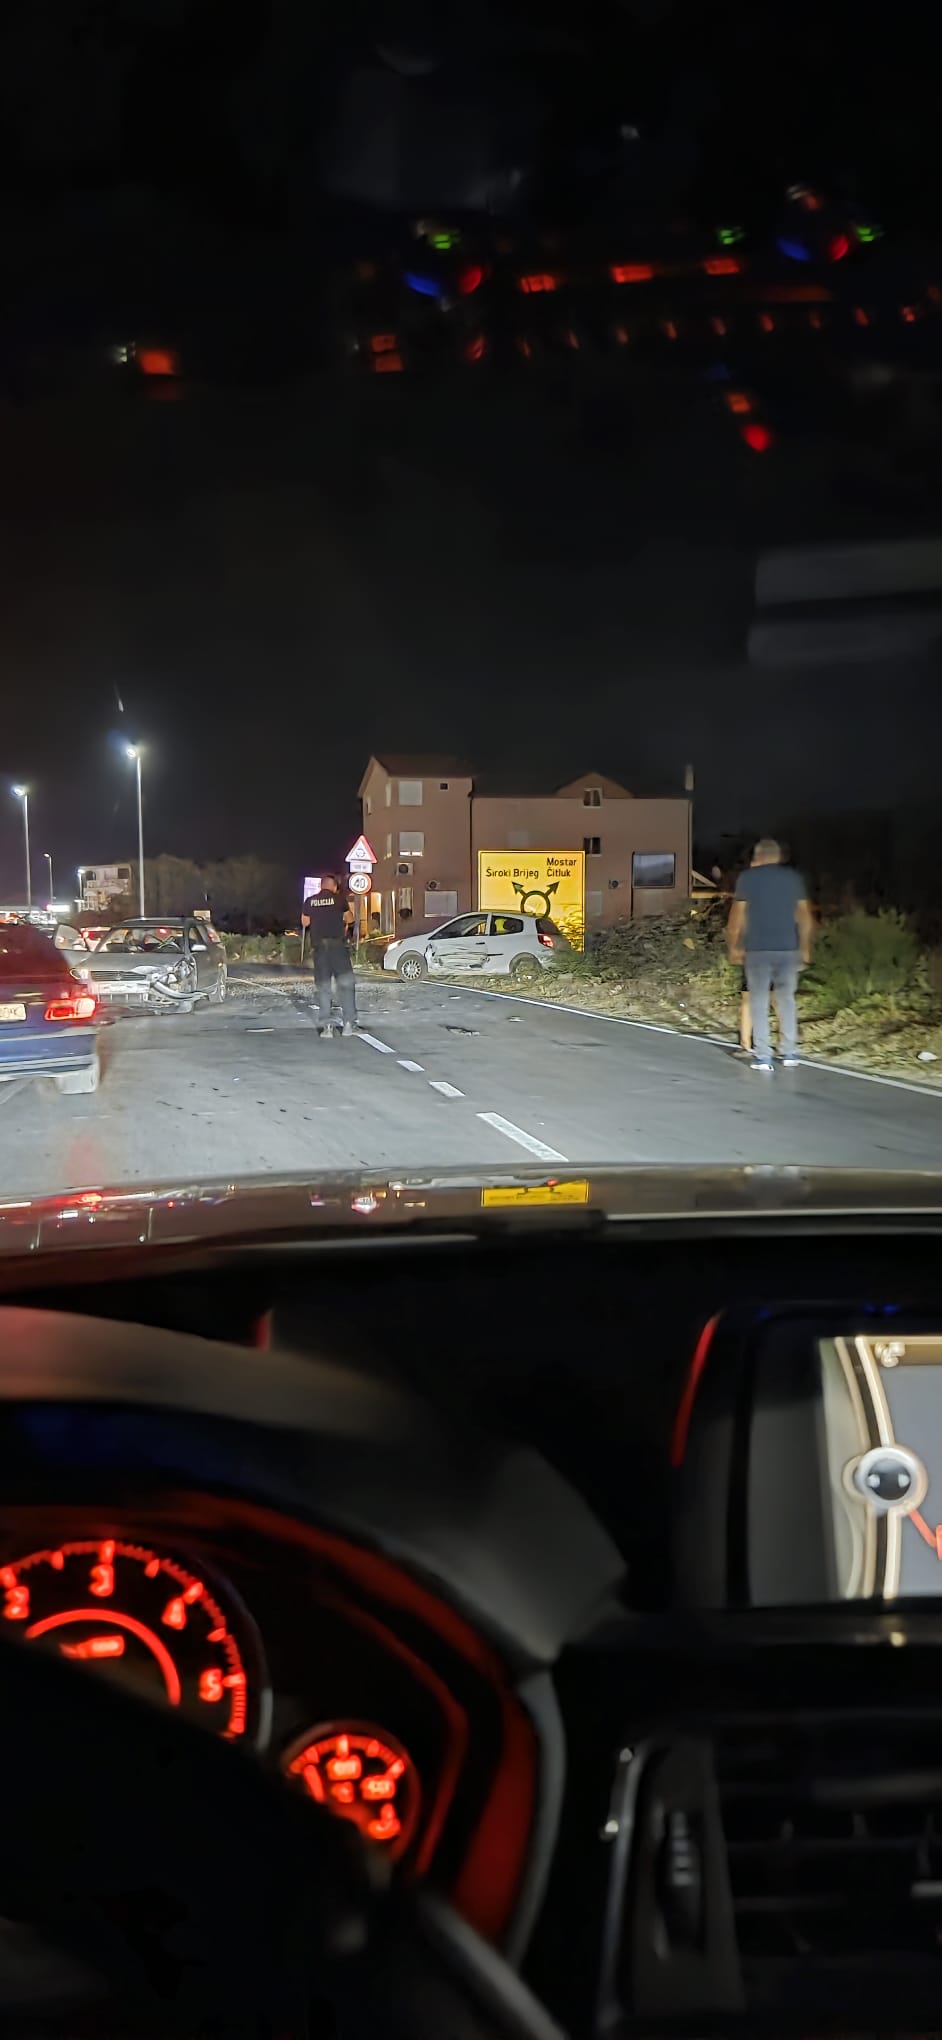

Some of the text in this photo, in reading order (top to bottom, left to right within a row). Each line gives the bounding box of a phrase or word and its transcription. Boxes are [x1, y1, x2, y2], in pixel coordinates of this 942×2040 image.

[546, 858, 577, 866] Mostar
[485, 866, 539, 879] Široki Brijeg
[546, 867, 571, 877] Čitluk
[353, 877, 366, 889] 40
[310, 897, 335, 907] POLICIJA
[90, 1564, 115, 1597] 3
[200, 1668, 223, 1702] 5
